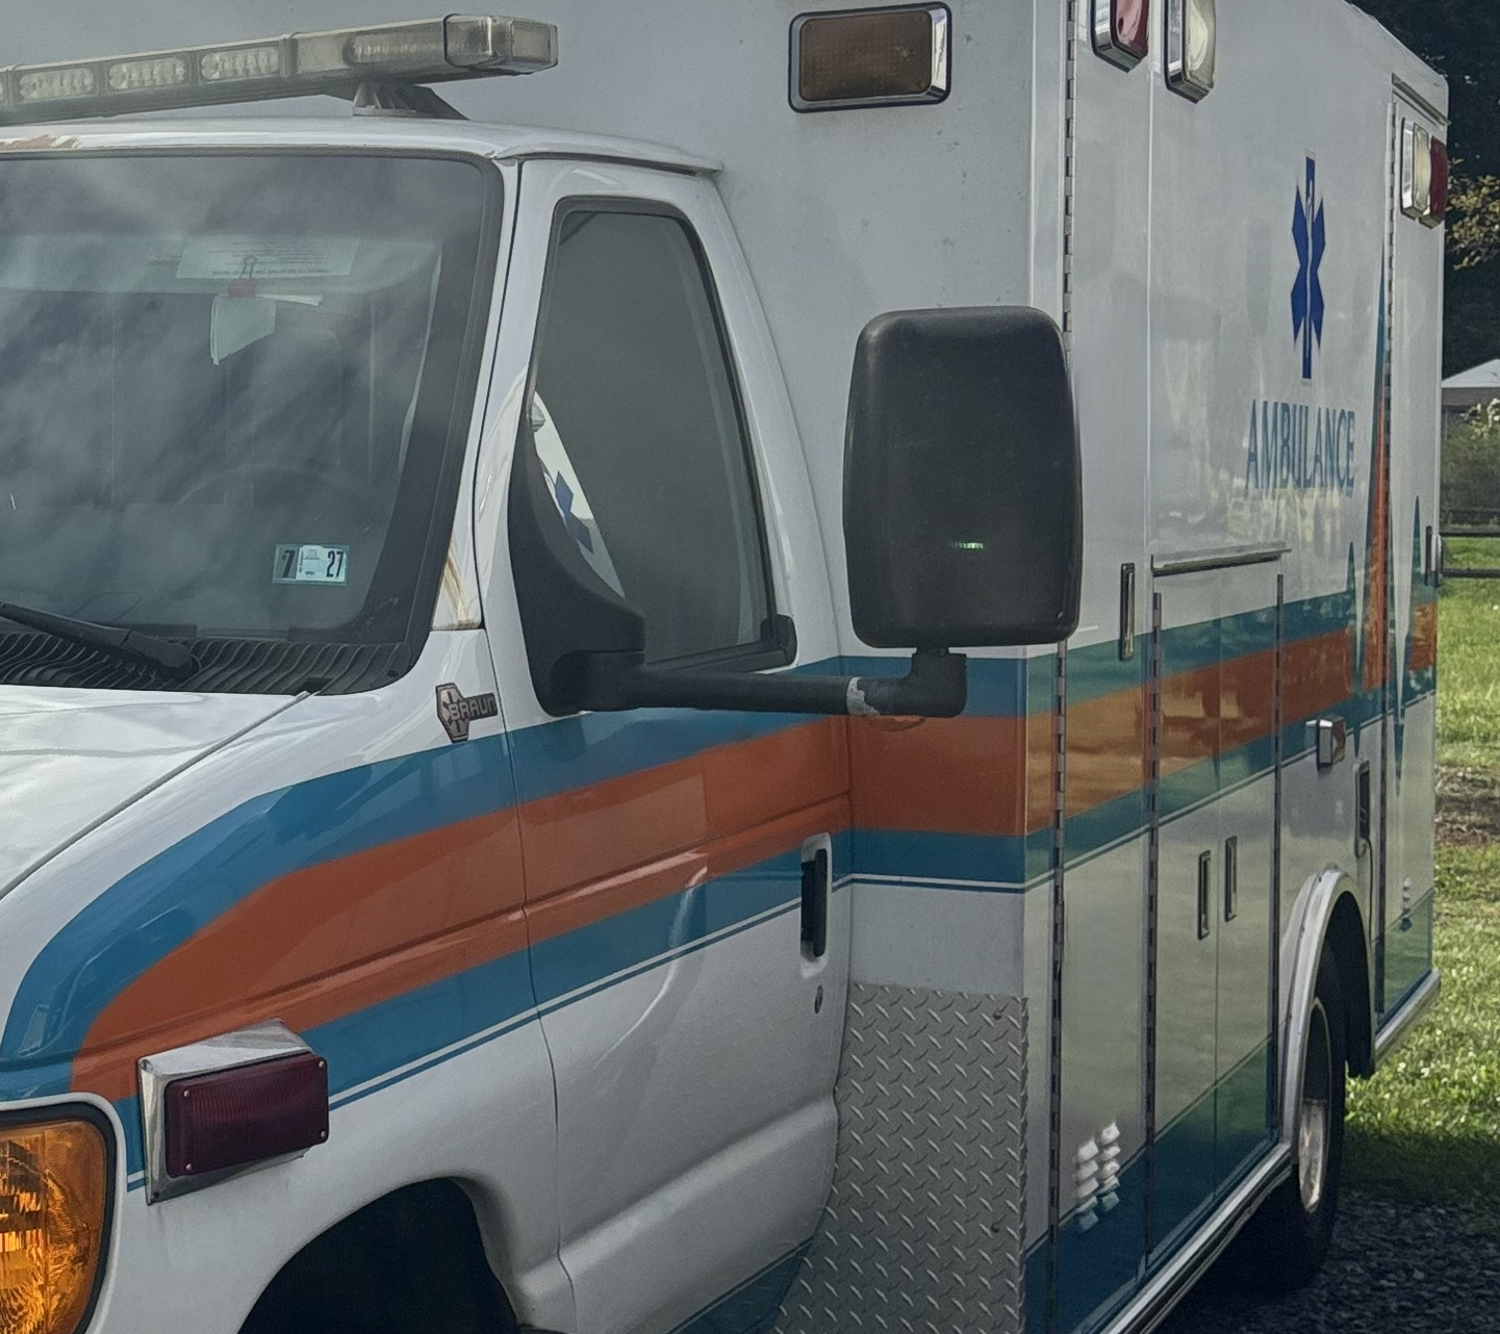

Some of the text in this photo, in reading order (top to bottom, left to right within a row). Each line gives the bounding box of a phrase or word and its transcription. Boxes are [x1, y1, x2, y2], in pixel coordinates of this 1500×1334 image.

[1244, 399, 1355, 497] AMBULANCE
[326, 550, 344, 578] 27
[448, 696, 497, 720] BRAUN
